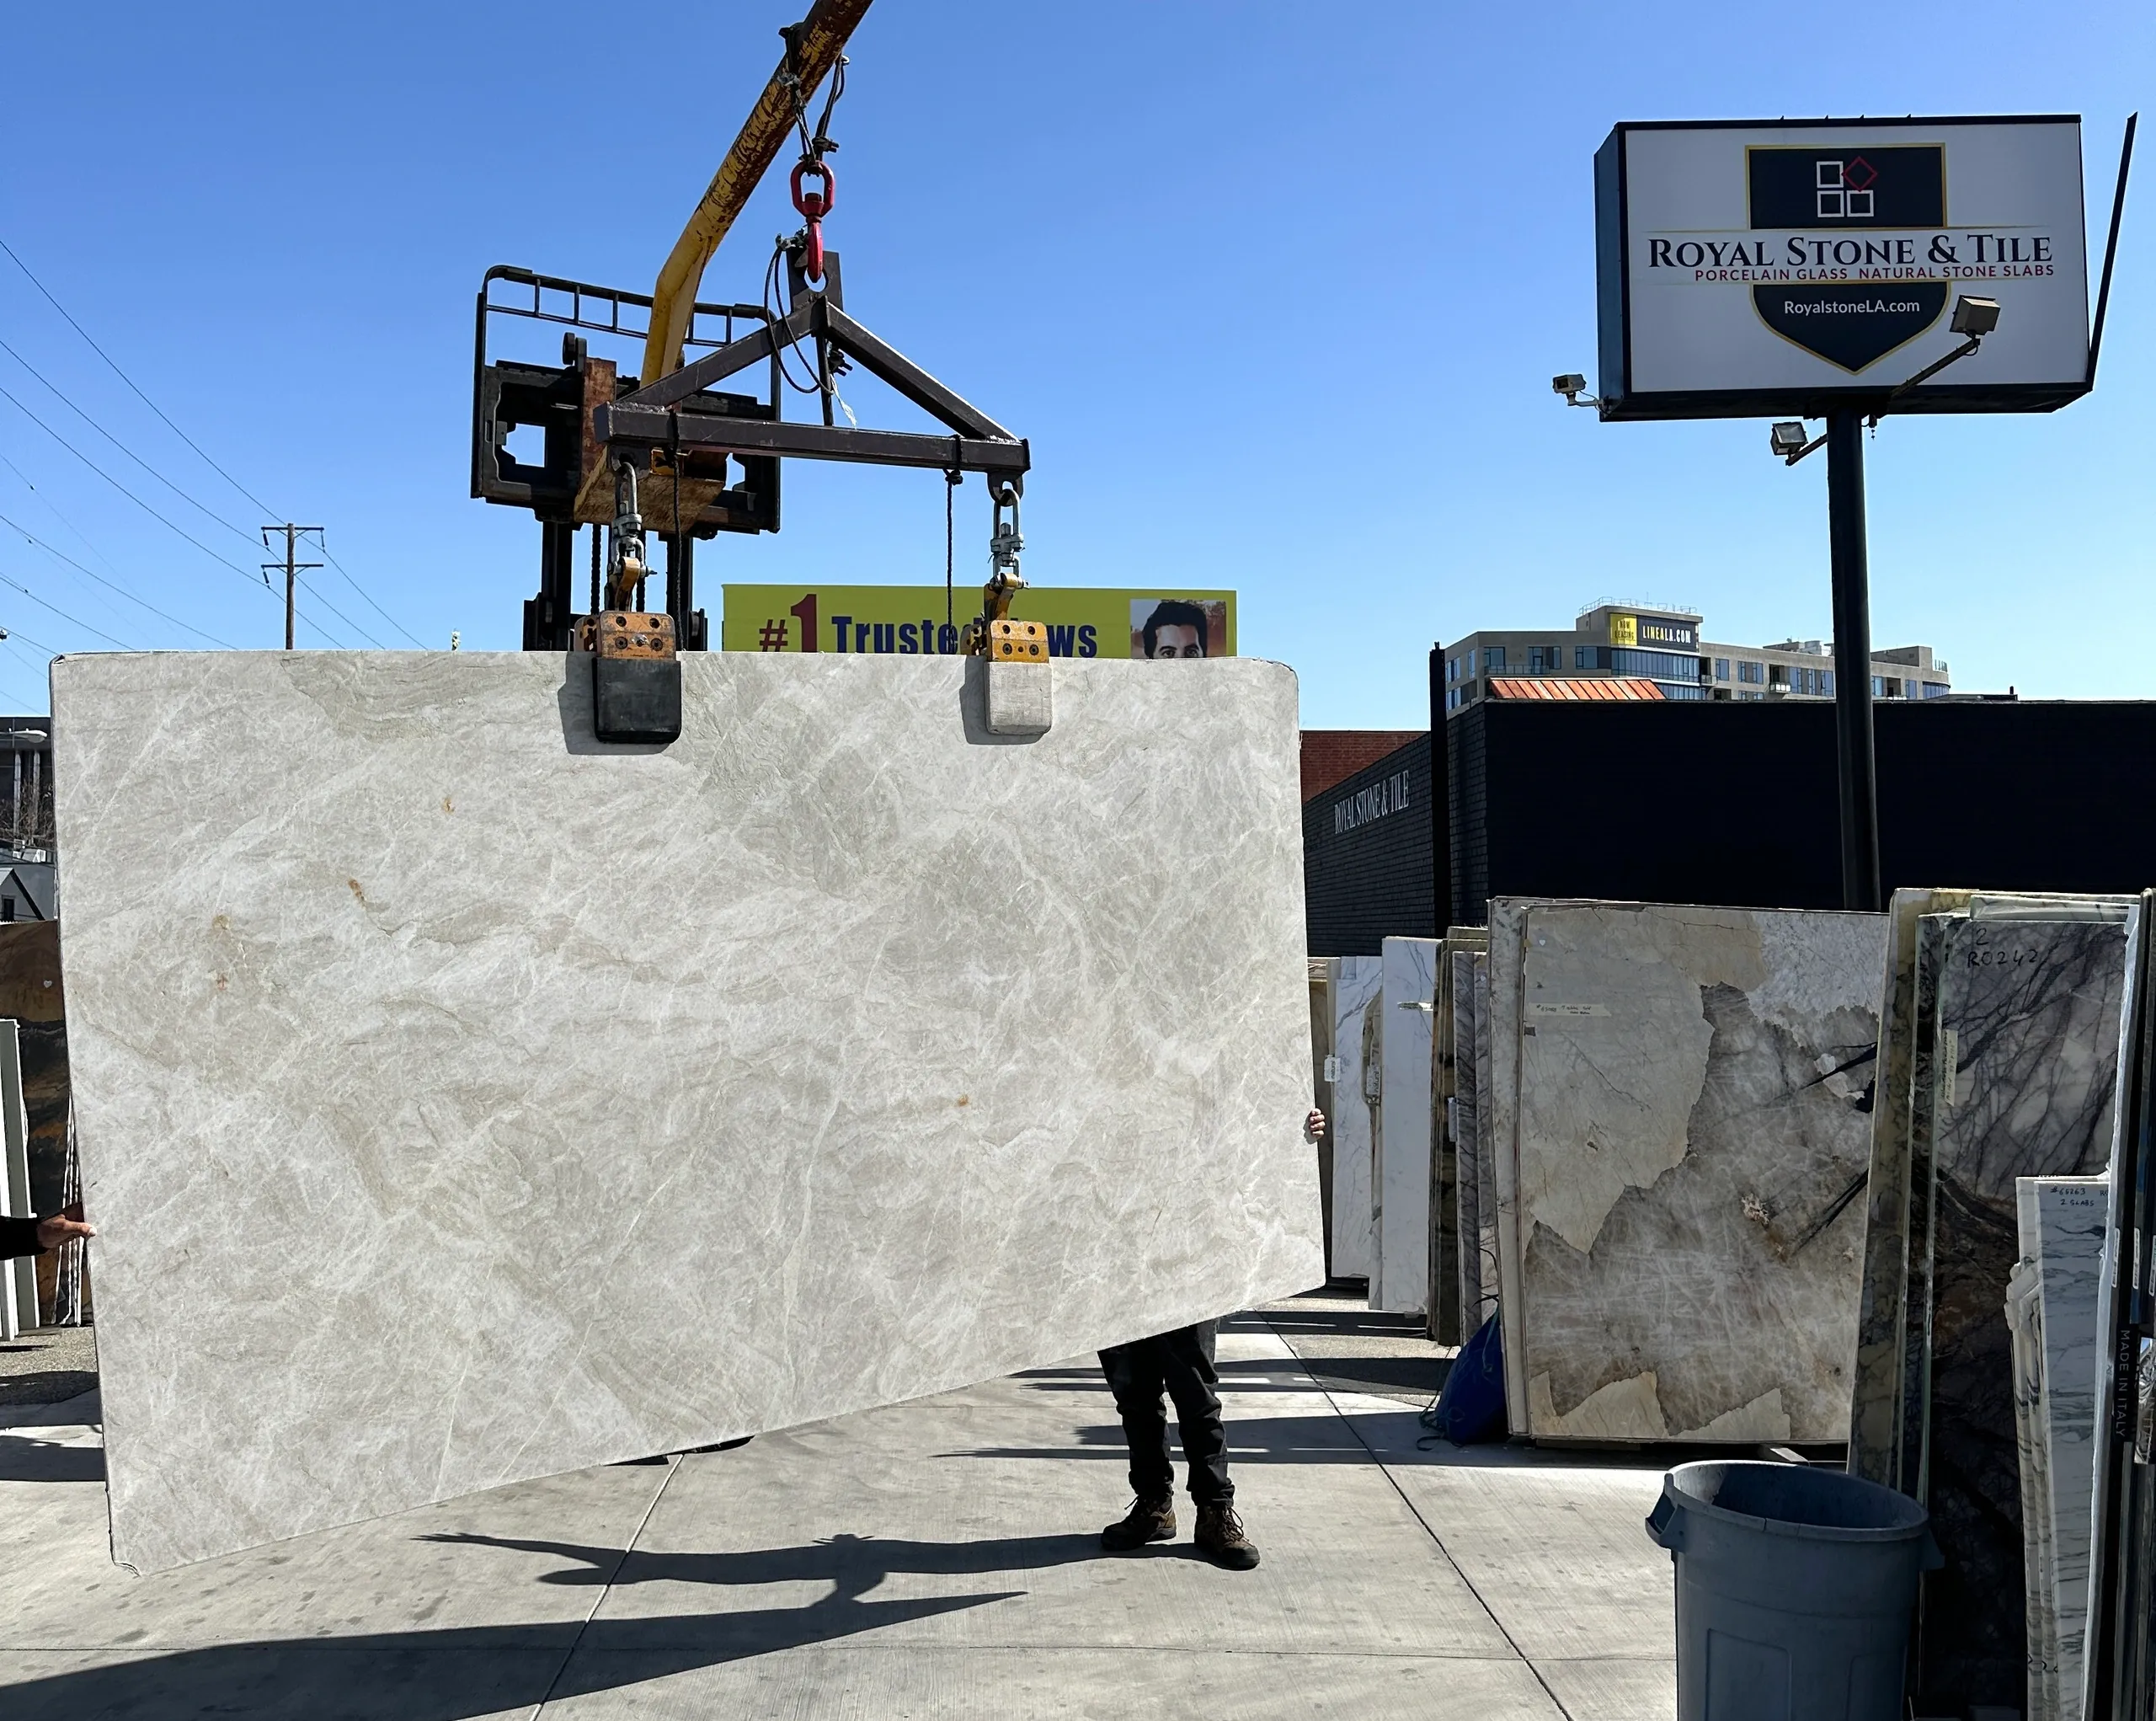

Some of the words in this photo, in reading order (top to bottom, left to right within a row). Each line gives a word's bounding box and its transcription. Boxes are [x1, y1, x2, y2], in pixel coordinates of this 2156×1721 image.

[1648, 238, 1775, 268] ROYAL
[1787, 237, 1916, 266] STONE
[1928, 234, 1961, 264] &
[1967, 233, 2052, 263] TILE
[1695, 270, 1790, 281] PORCELAIN
[1796, 268, 1848, 280] GLASS
[1859, 266, 1936, 280] NATURAL
[1942, 265, 1997, 278] STONE
[2003, 265, 2054, 277] SLABS
[1784, 299, 1920, 317] RoyalstoneLA.com
[759, 593, 818, 653] #1
[831, 616, 987, 655] Truste
[1642, 625, 1691, 644] LINEALA.COM
[1334, 795, 1357, 835] ROYAL
[1356, 783, 1382, 826] STONE
[1381, 779, 1389, 817] &
[1390, 770, 1410, 813] TILE
[1976, 927, 1989, 945] 2
[2120, 1329, 2131, 1372] MADE
[2118, 1377, 2128, 1392] IN
[2116, 1398, 2127, 1437] ITALY
